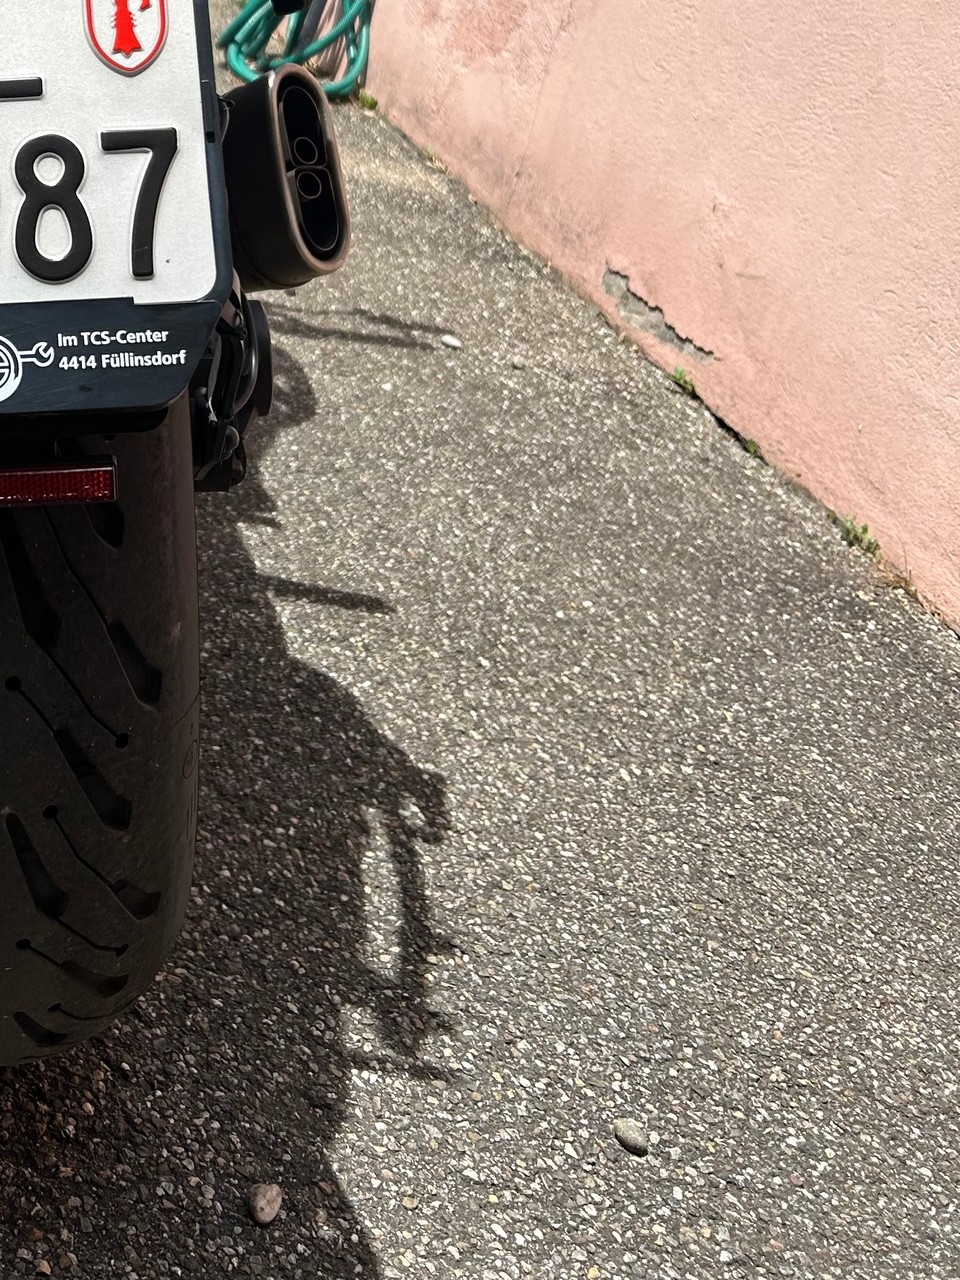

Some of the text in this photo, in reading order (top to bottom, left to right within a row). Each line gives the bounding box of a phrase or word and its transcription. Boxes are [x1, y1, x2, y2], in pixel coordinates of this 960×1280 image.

[57, 329, 170, 348] Im TCS-Center
[58, 349, 188, 371] 4414 Füllinsdorf
